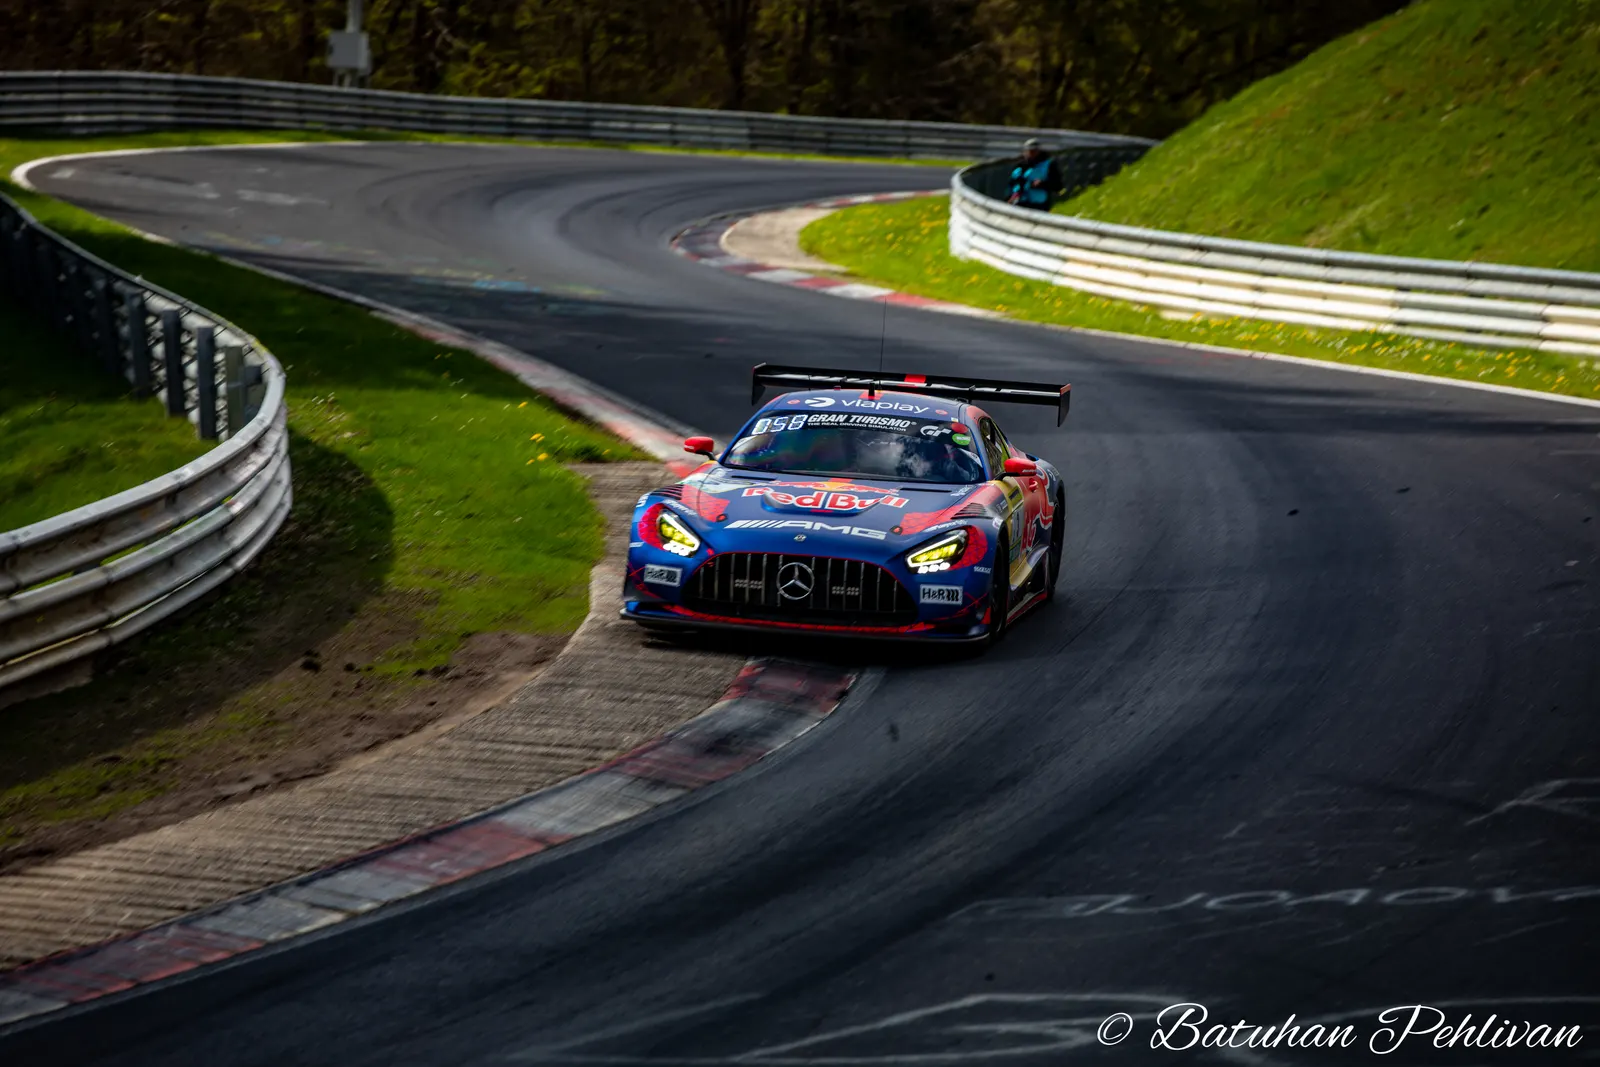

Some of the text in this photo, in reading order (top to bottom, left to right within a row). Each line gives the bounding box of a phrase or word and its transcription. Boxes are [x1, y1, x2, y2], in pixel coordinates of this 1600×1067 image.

[841, 399, 930, 414] viaplay
[807, 414, 911, 428] GRAN TURISMO
[868, 424, 907, 432] SIMULATOR
[741, 487, 910, 511] Red Bull
[773, 520, 888, 541] AMG
